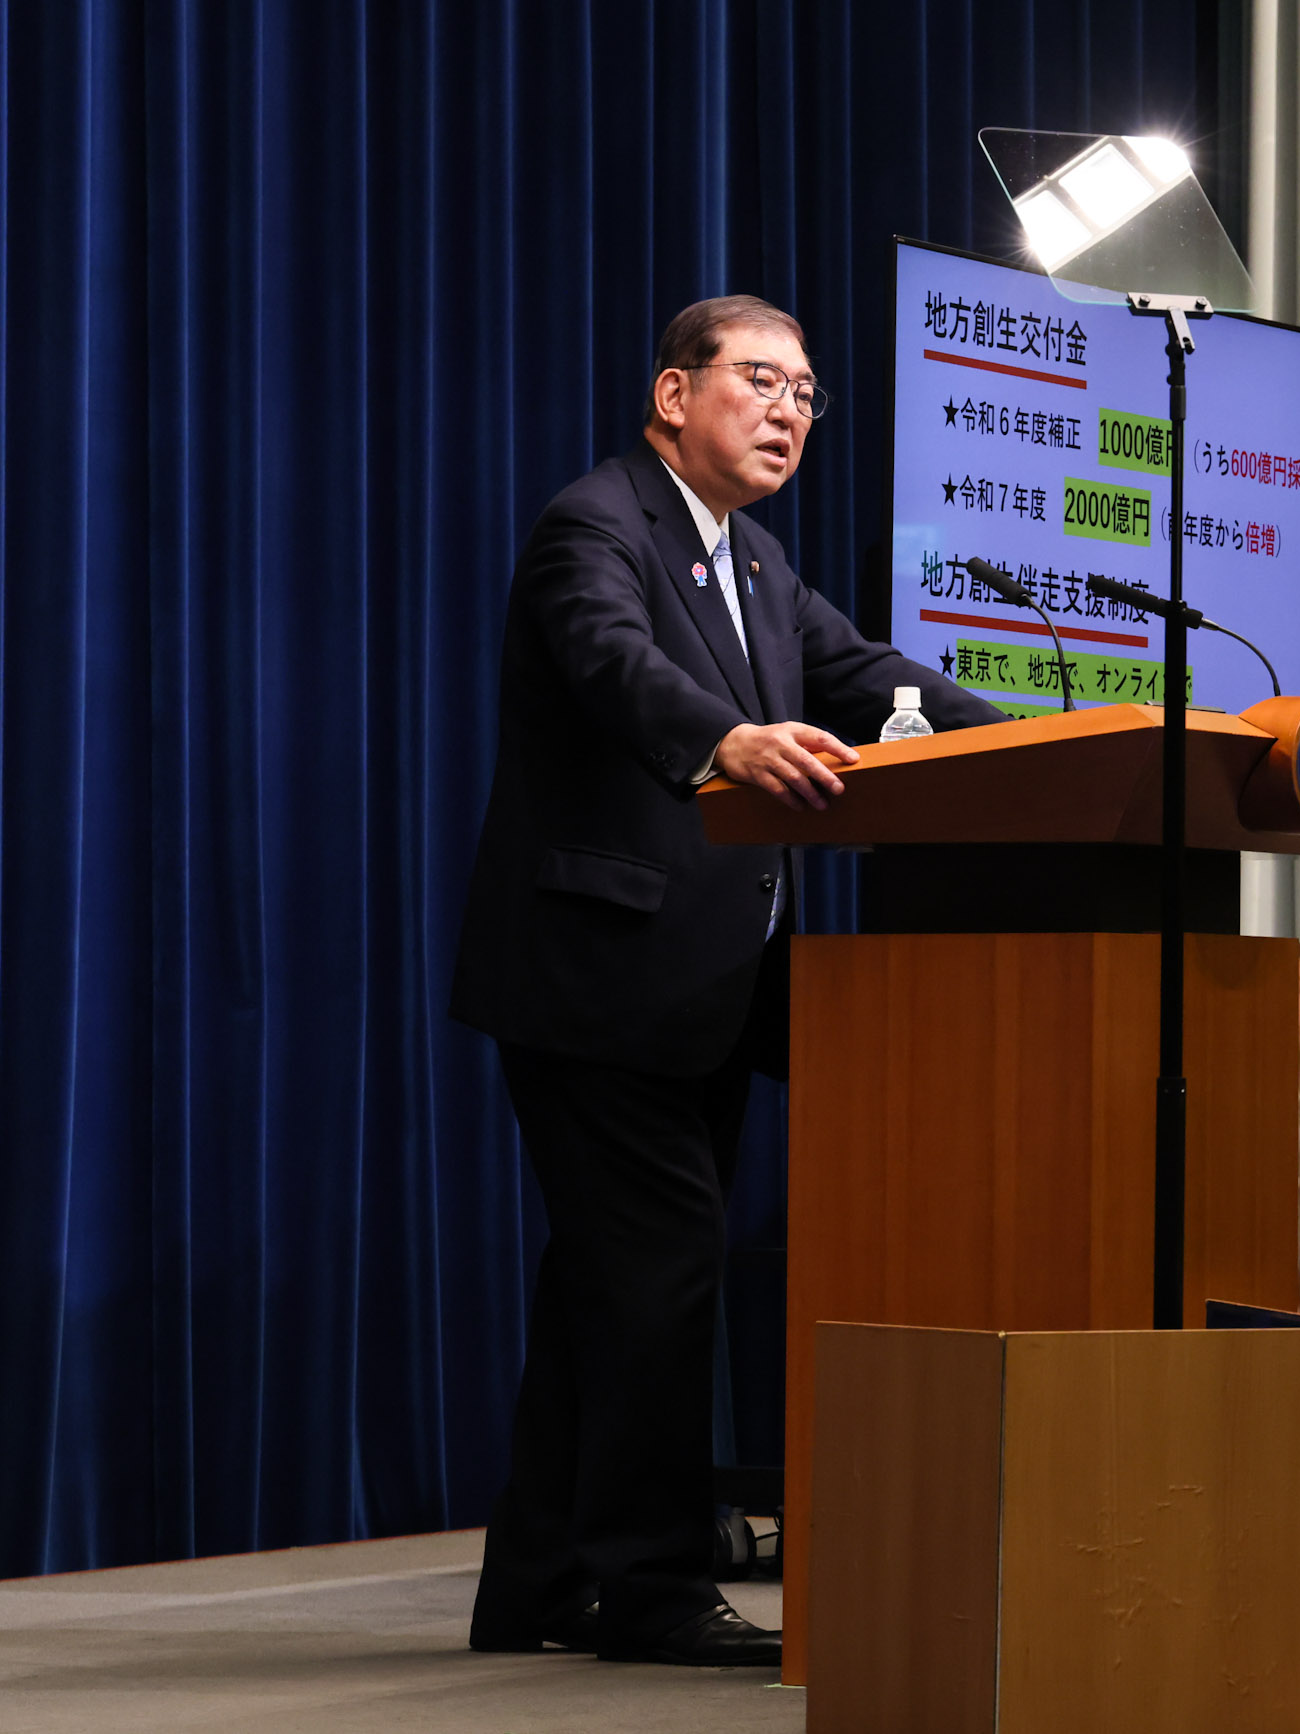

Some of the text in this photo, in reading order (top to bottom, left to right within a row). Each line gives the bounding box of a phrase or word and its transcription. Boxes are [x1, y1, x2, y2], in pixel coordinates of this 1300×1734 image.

[925, 290, 1087, 366] 地方創生交付金
[959, 475, 1281, 558] 令和7年度 2000億円 （年度から倍増）
